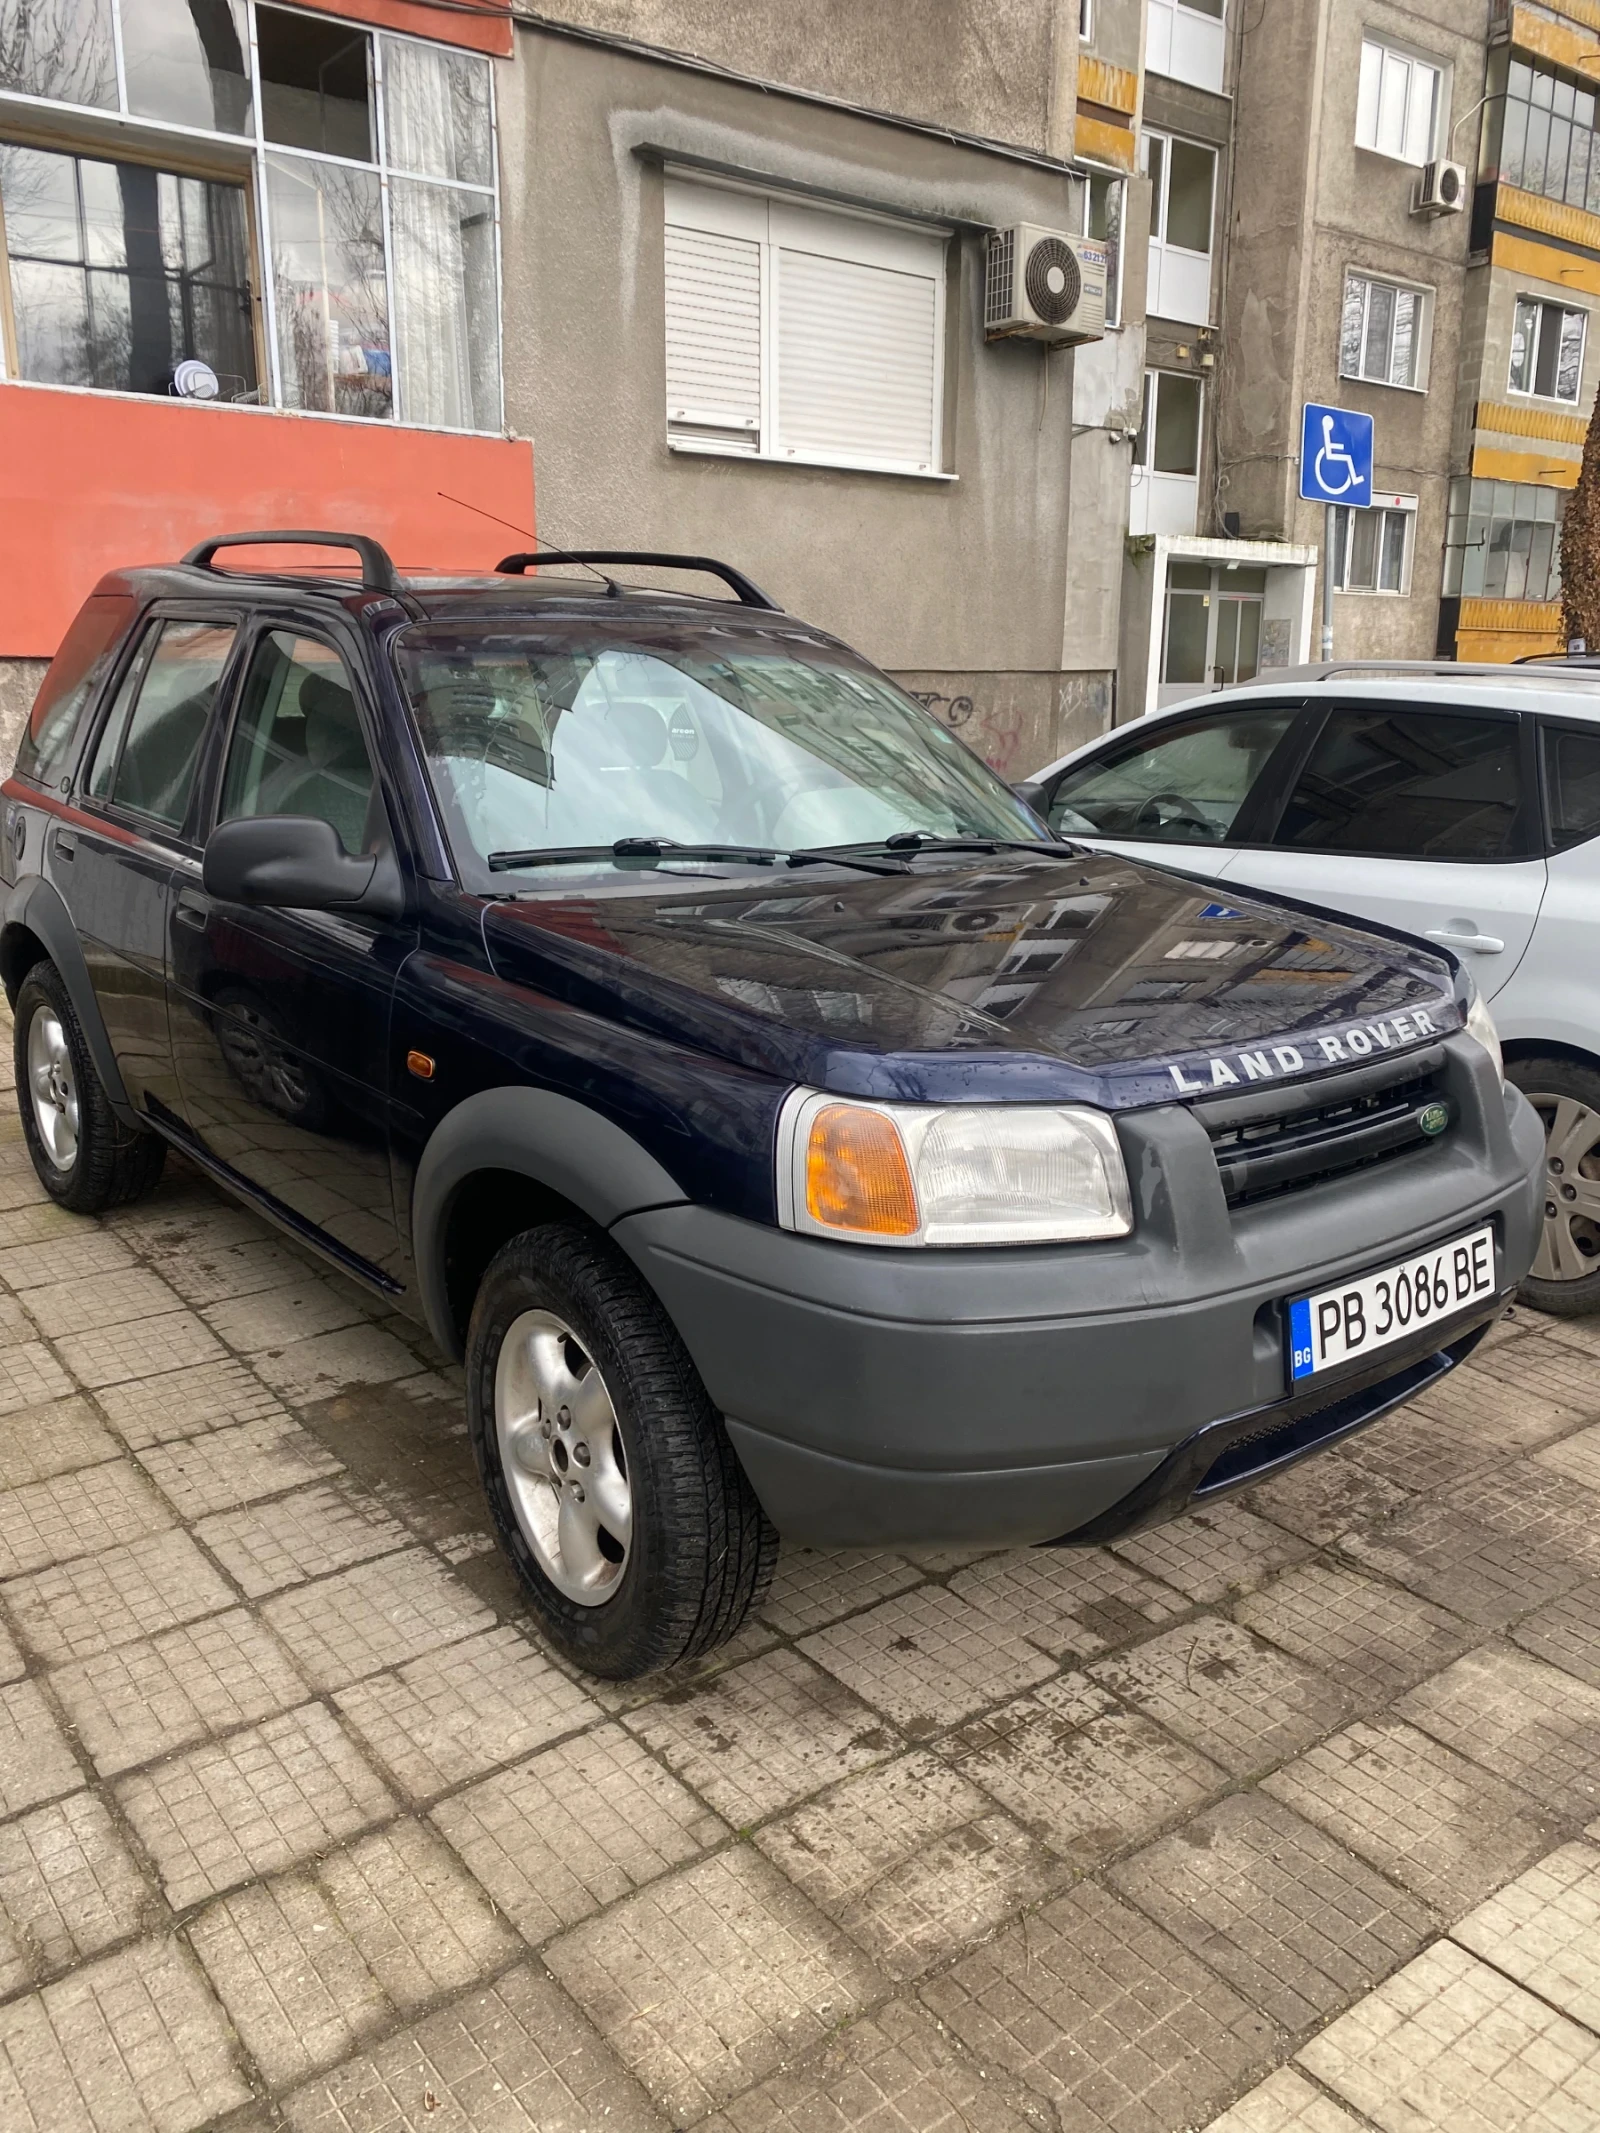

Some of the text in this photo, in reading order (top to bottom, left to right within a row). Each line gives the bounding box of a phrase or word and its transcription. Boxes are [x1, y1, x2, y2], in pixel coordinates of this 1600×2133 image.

[1169, 1010, 1438, 1093] LAND ROVER
[1318, 1237, 1491, 1360] PB 3086 BE
[1294, 1348, 1311, 1369] BG
